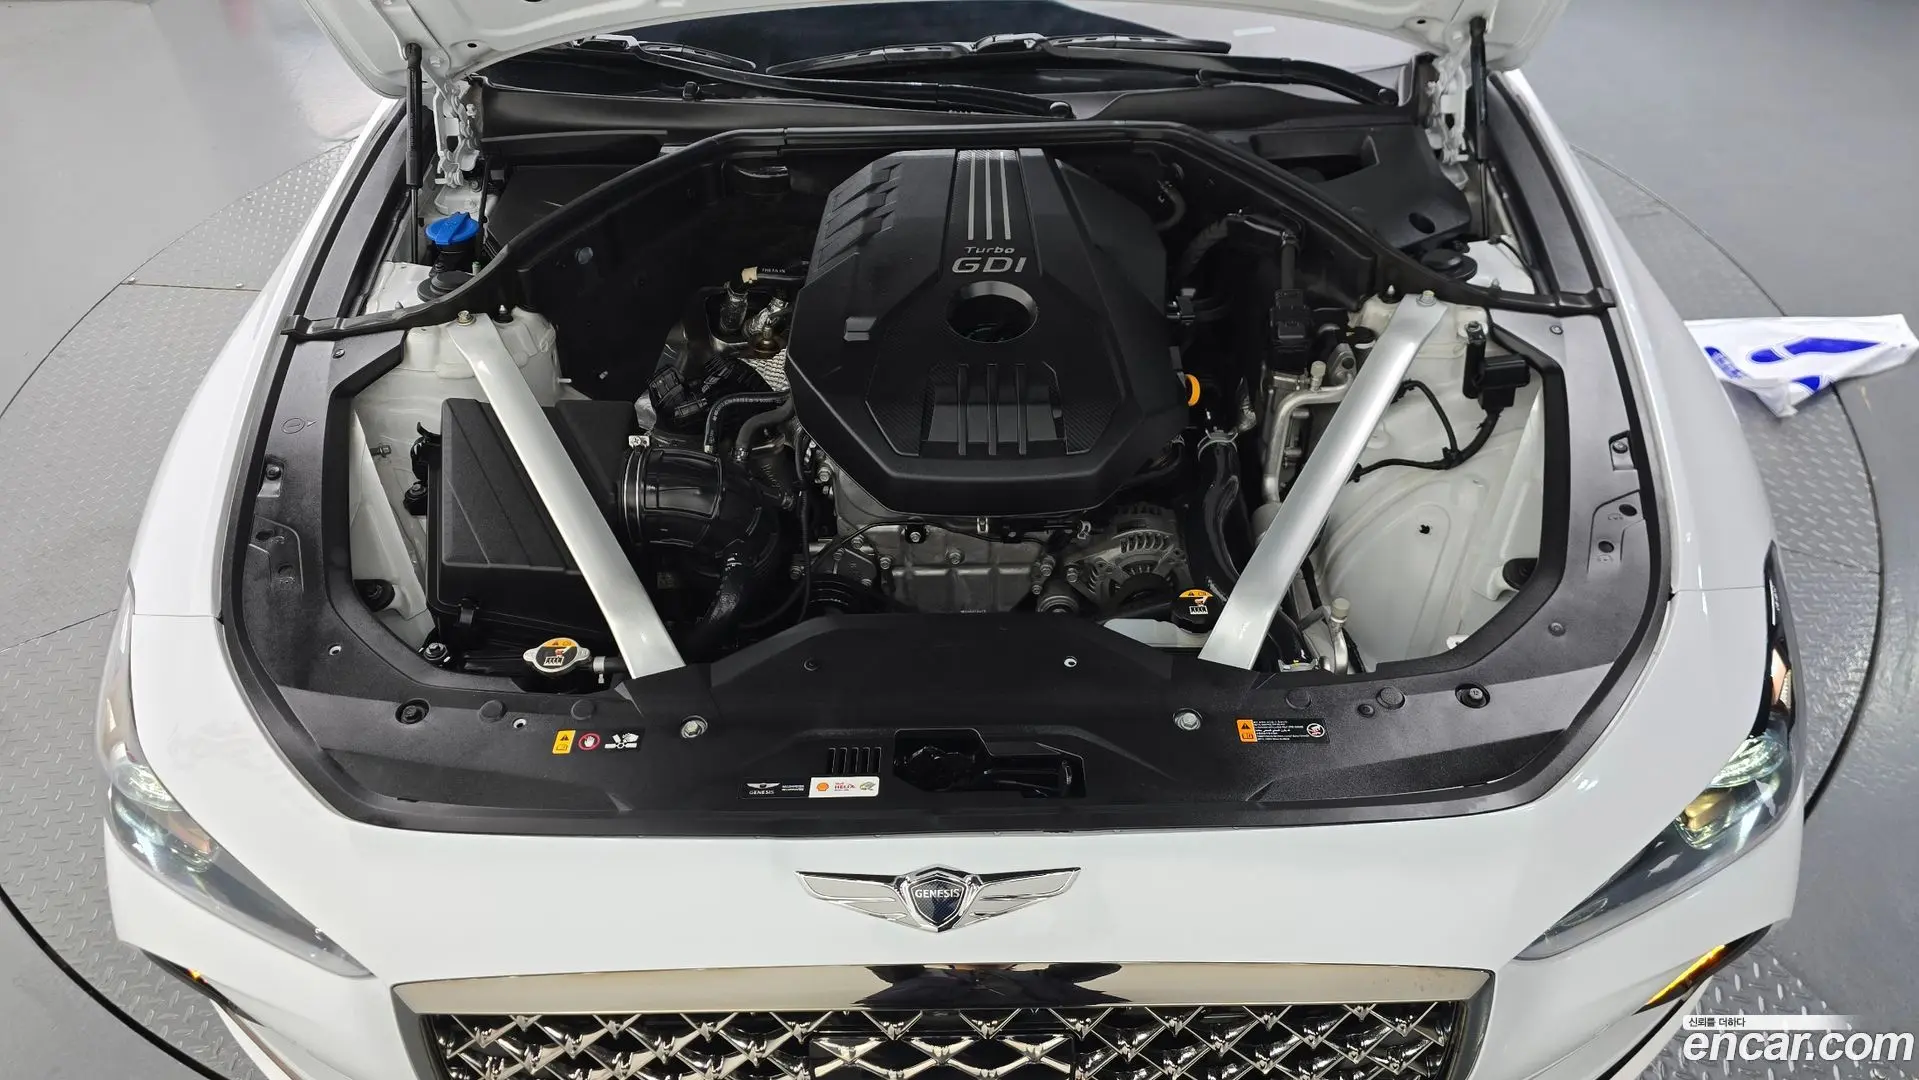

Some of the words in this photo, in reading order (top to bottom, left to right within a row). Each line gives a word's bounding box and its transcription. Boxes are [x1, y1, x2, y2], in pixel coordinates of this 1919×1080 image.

[964, 246, 1015, 254] Turbo
[951, 256, 1027, 273] GDI
[914, 888, 961, 898] GENESIS
